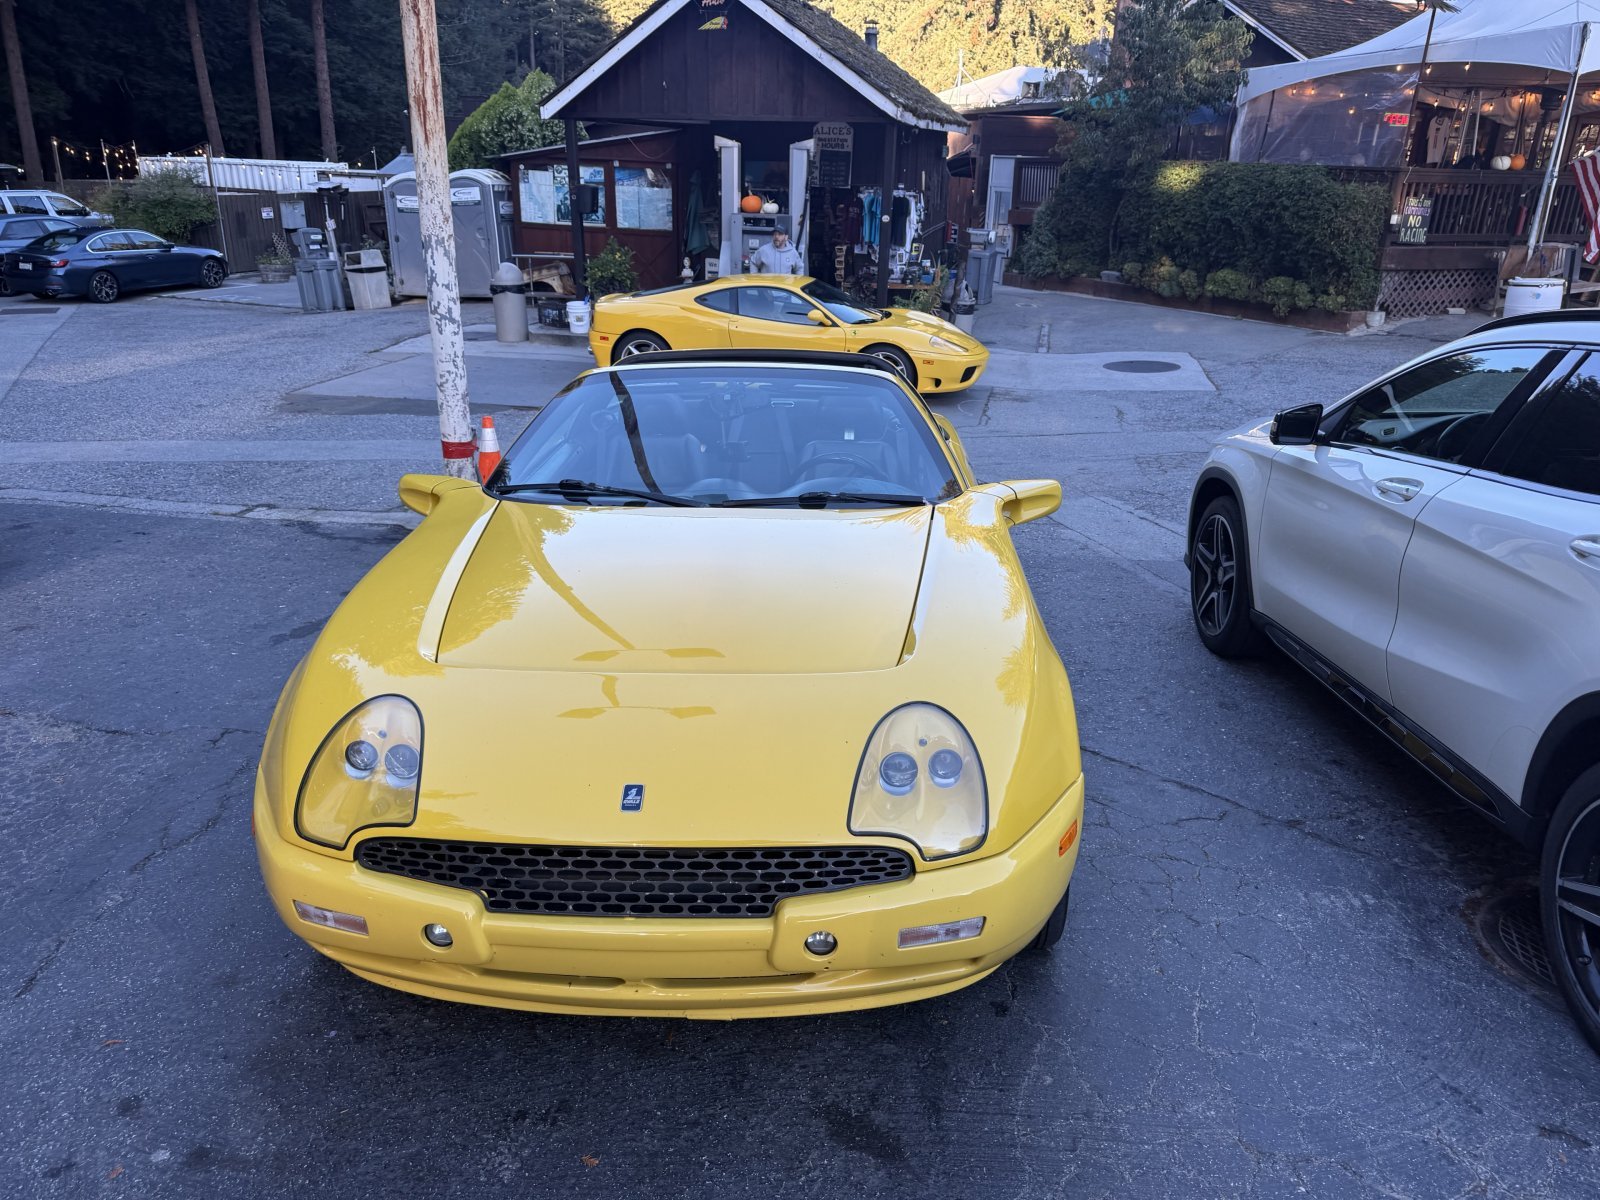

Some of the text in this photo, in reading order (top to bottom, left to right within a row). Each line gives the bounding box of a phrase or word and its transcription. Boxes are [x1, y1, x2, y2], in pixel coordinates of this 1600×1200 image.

[815, 126, 852, 136] ALICE'S
[1407, 215, 1422, 227] NO
[1400, 228, 1427, 243] RACING
